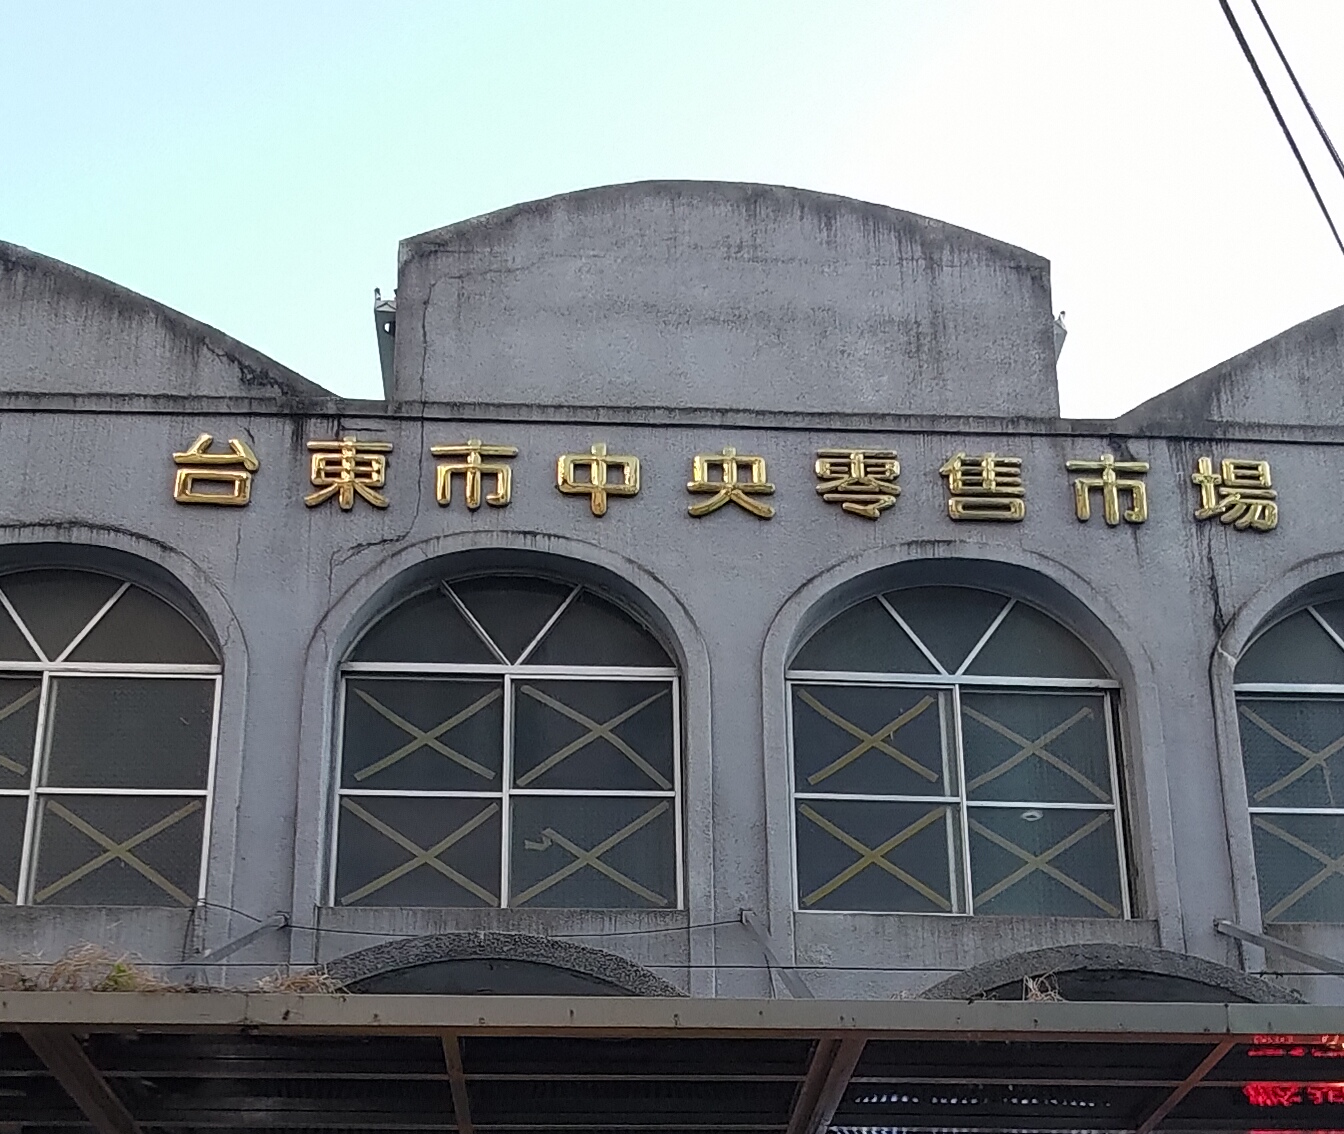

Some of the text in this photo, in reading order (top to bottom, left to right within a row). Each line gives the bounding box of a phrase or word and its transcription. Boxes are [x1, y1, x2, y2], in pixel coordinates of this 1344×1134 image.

[172, 431, 1284, 532] 台東市中央零售市場
